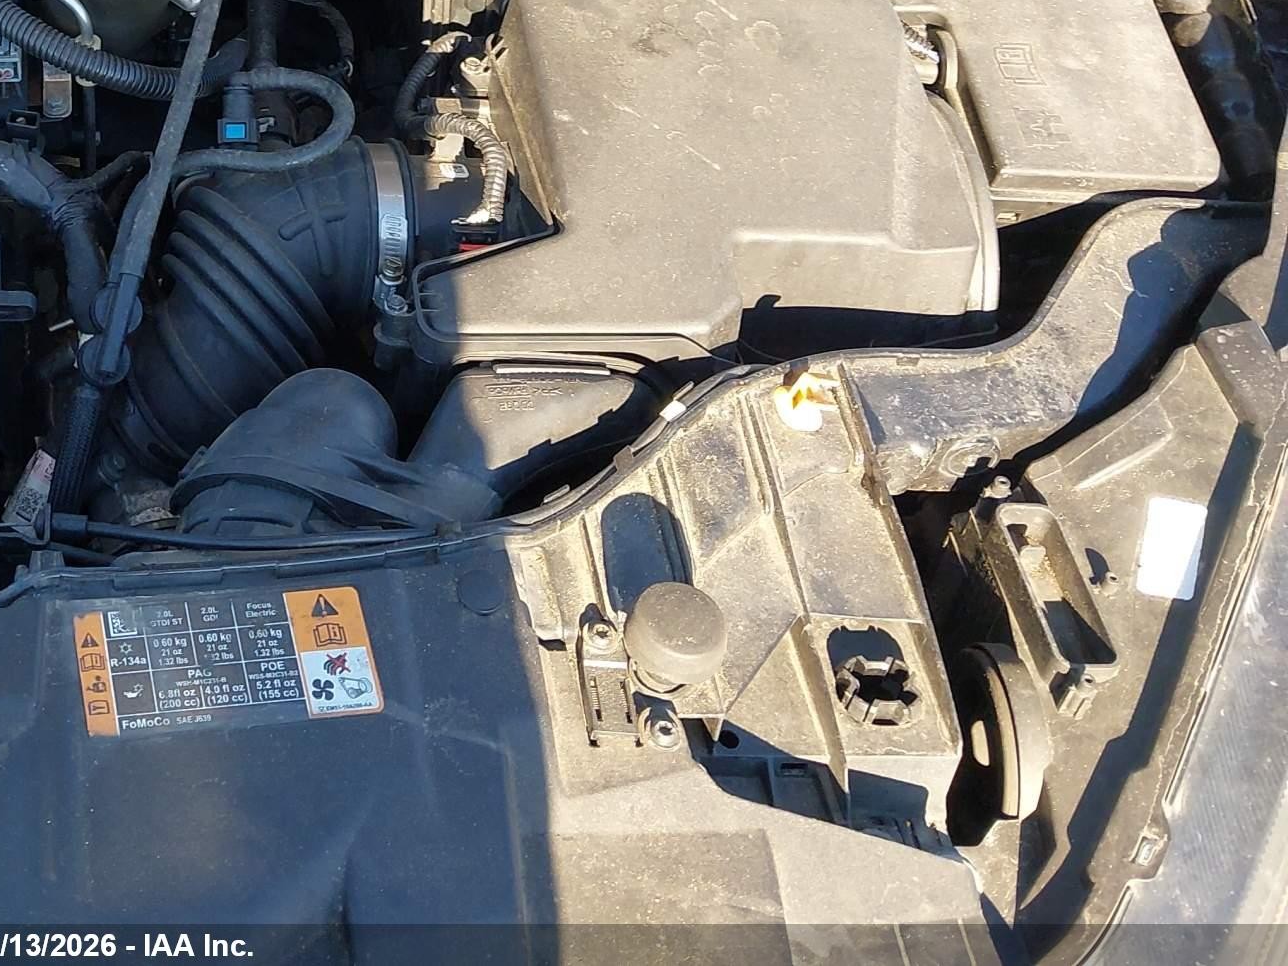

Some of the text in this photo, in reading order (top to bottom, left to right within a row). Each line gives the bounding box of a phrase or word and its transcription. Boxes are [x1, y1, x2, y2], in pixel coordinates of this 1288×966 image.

[200, 606, 219, 614] 2.0L
[246, 602, 272, 610] Focus
[245, 610, 277, 618] Electric
[172, 617, 183, 625] ST
[198, 632, 232, 643] 0.60 kg
[248, 629, 283, 639] 0.60 kg
[174, 637, 187, 647] kg
[161, 648, 170, 656] 21
[206, 643, 229, 652] 21 oz
[221, 652, 234, 660] lbs
[254, 649, 271, 657] 1.32
[110, 656, 147, 667] R-134a
[260, 661, 286, 672] POE
[187, 669, 212, 679] PAG
[204, 684, 246, 695] 4.0 fl oz
[256, 680, 272, 690] 5.2
[273, 679, 282, 688] fl
[183, 689, 197, 697] oz
[258, 688, 300, 702] (155 cc)
[159, 697, 201, 710] (200 cc)
[206, 692, 248, 706] (120 cc)
[121, 716, 171, 730] FoMoCo
[176, 715, 193, 725] SAE
